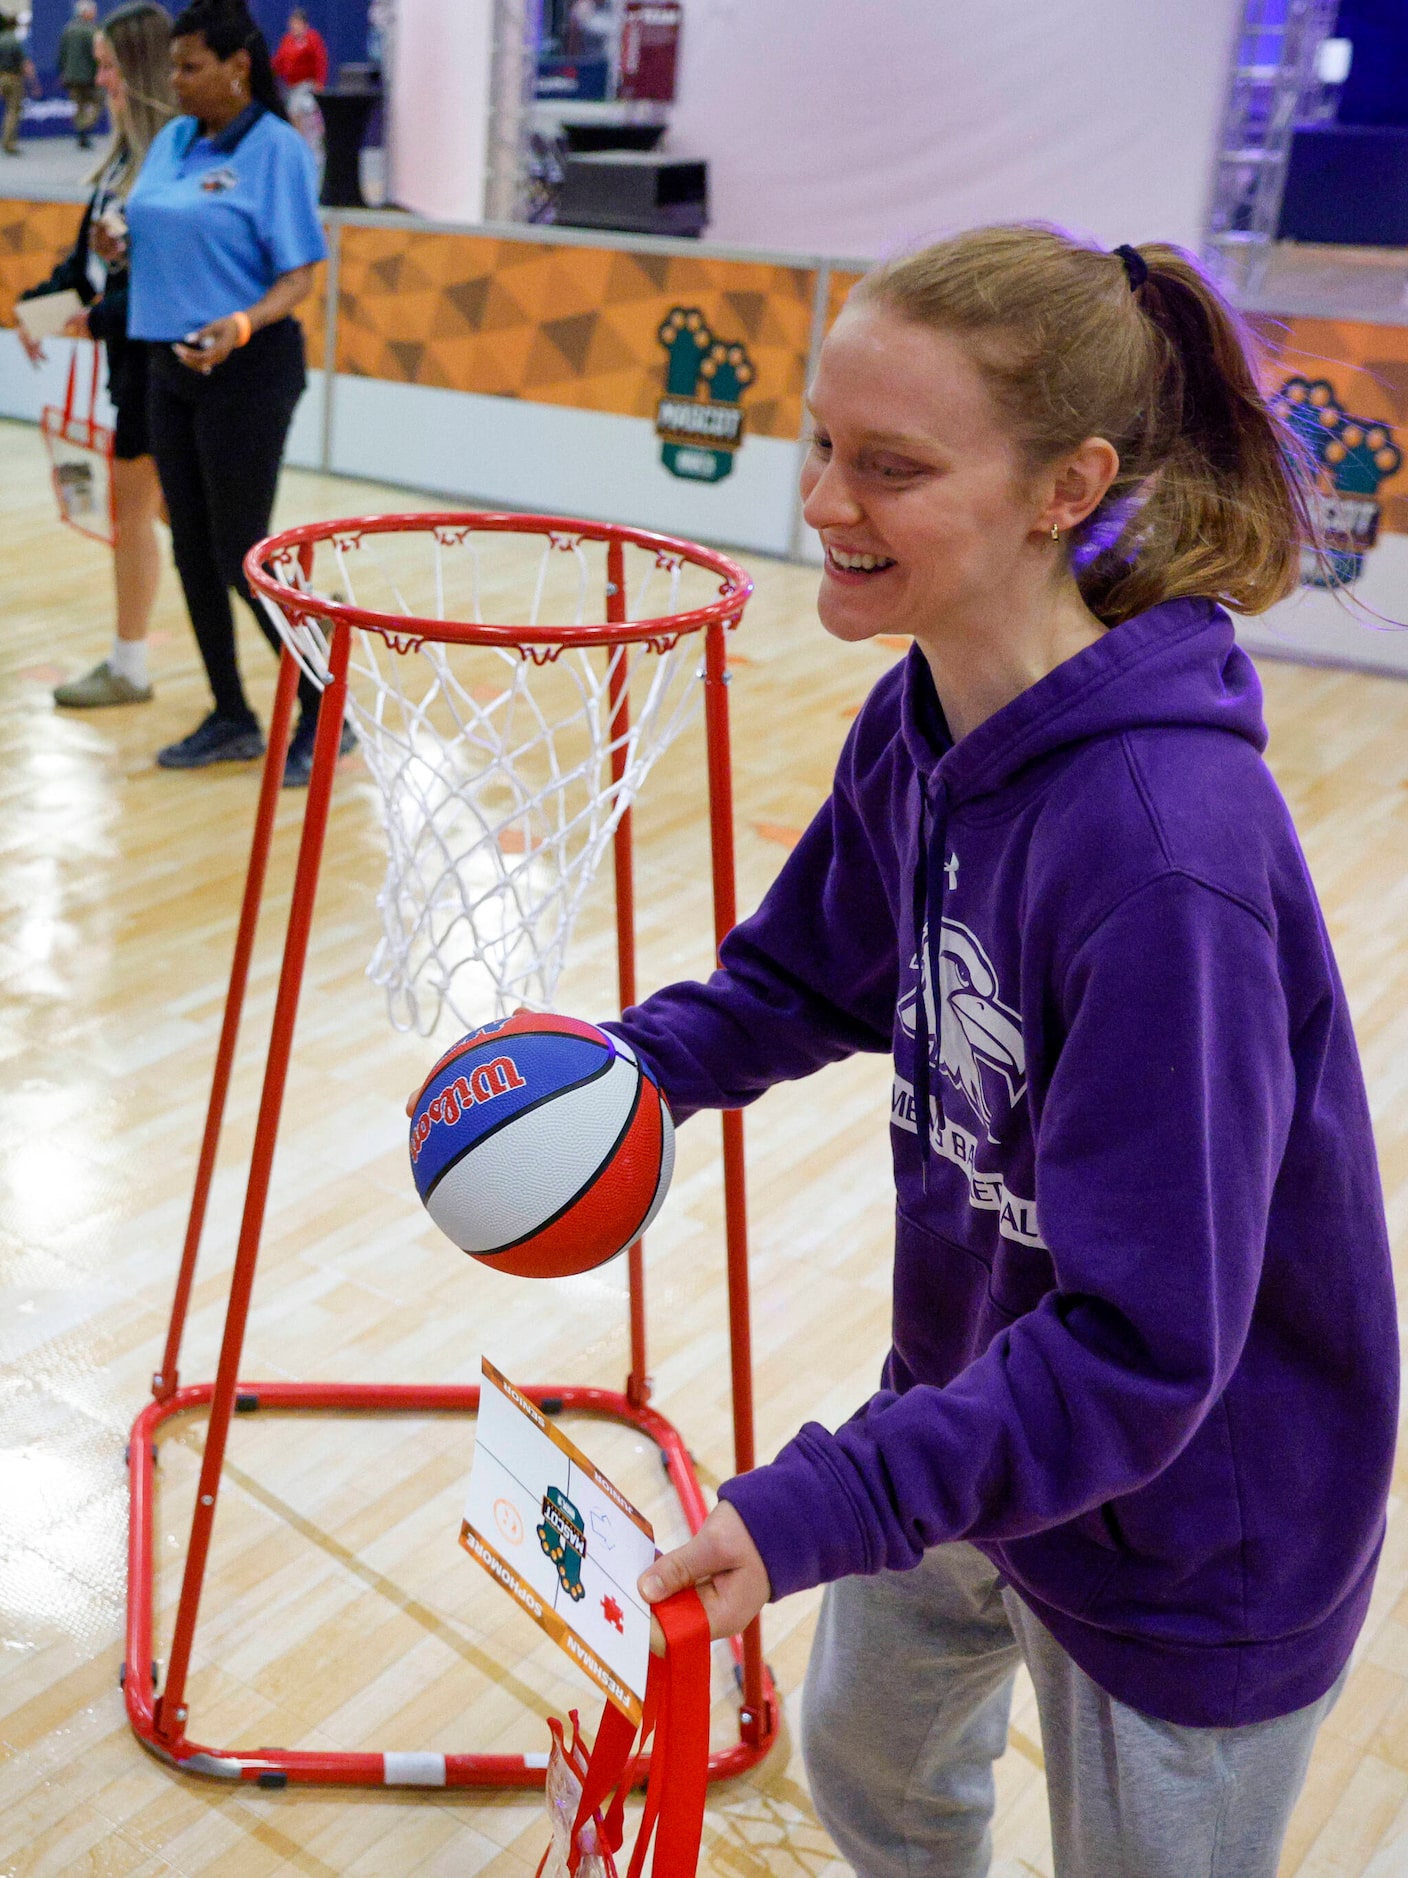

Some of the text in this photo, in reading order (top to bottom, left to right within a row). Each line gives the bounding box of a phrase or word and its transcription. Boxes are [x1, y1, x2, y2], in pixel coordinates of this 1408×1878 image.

[503, 1381, 545, 1429] SENIOR
[594, 1470, 633, 1514] JUNIOR
[543, 1505, 585, 1555] MASCOT
[466, 1533, 544, 1618] SOPHOMORE
[566, 1635, 632, 1709] FRESHMAN
